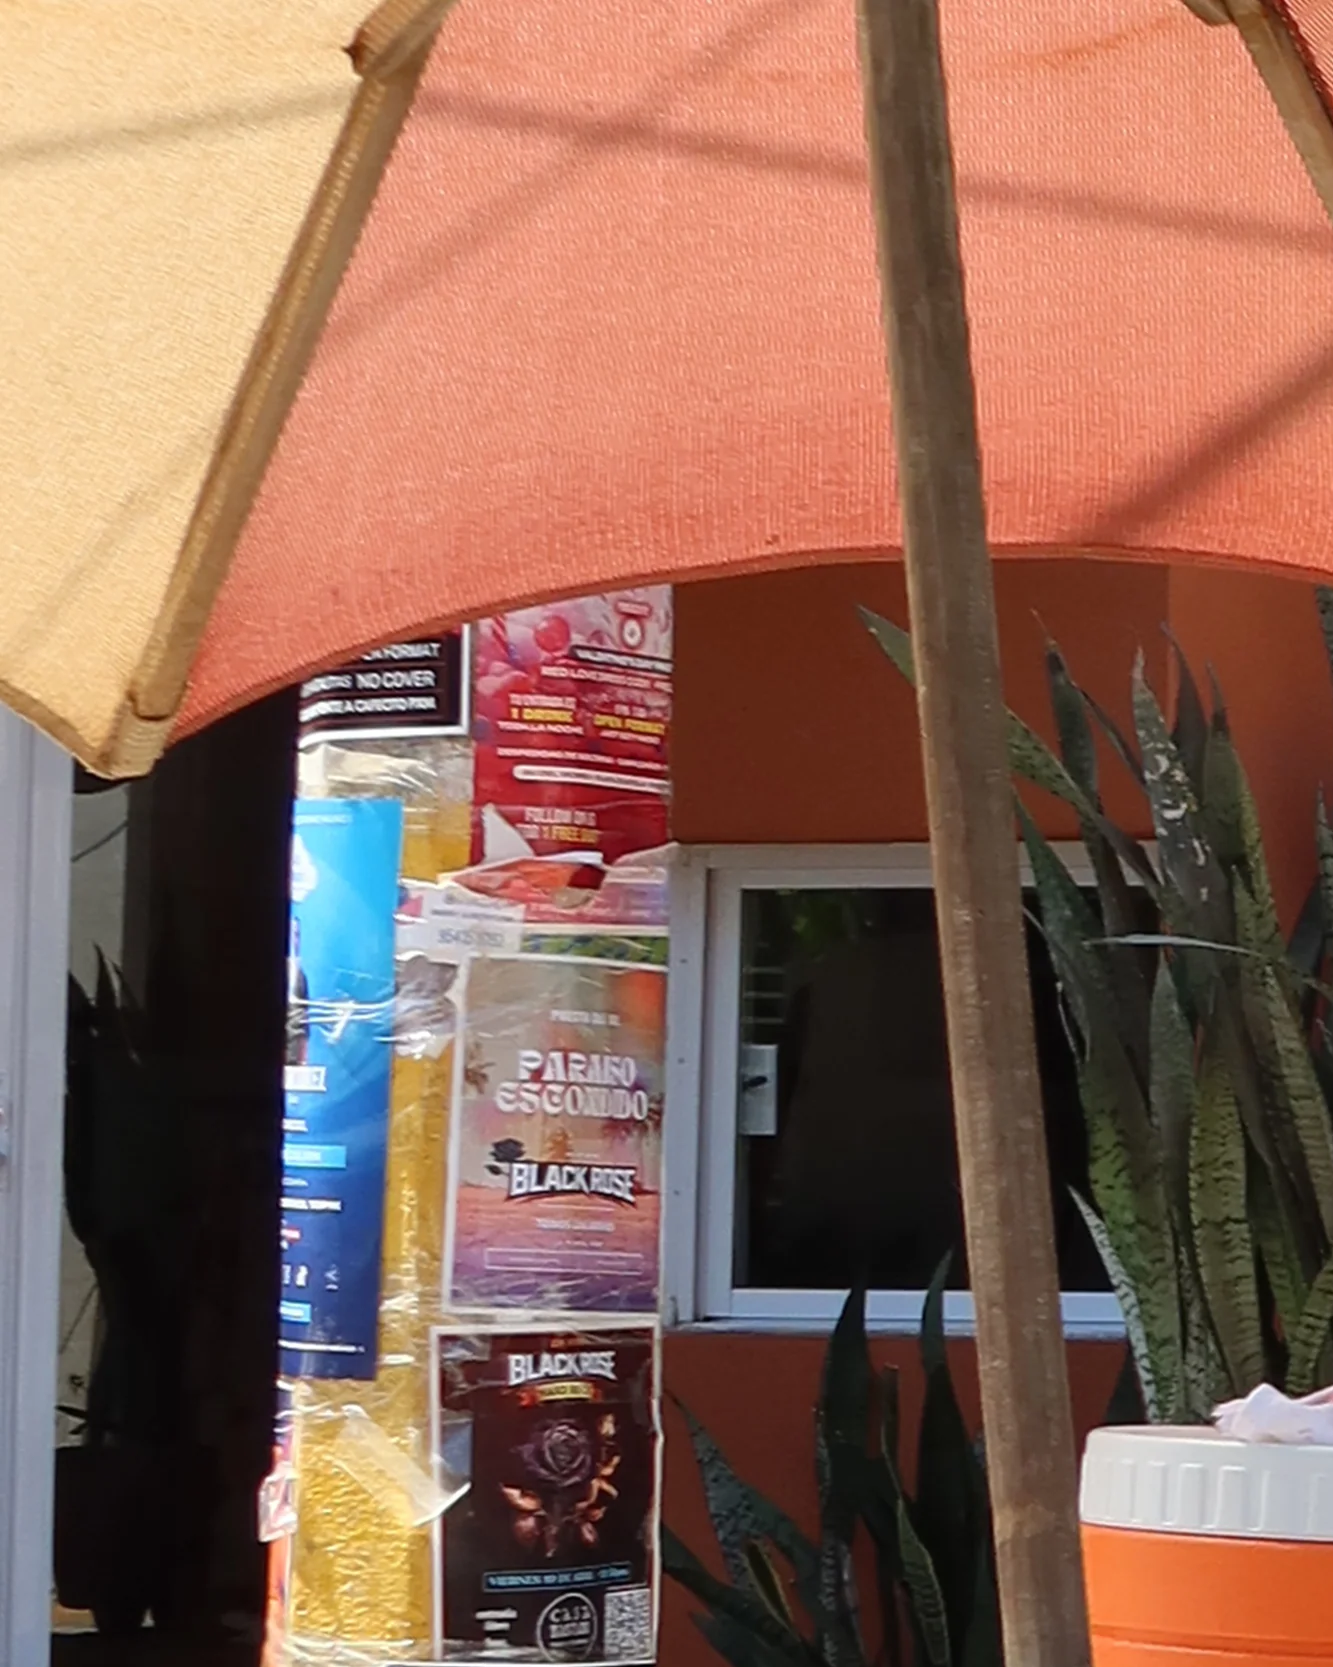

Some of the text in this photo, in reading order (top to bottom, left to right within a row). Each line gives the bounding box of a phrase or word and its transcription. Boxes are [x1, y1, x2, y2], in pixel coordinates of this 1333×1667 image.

[355, 672, 381, 690] NO
[383, 669, 437, 688] COVER
[510, 1162, 590, 1197] BLACK
[508, 1352, 582, 1386] BLACK
